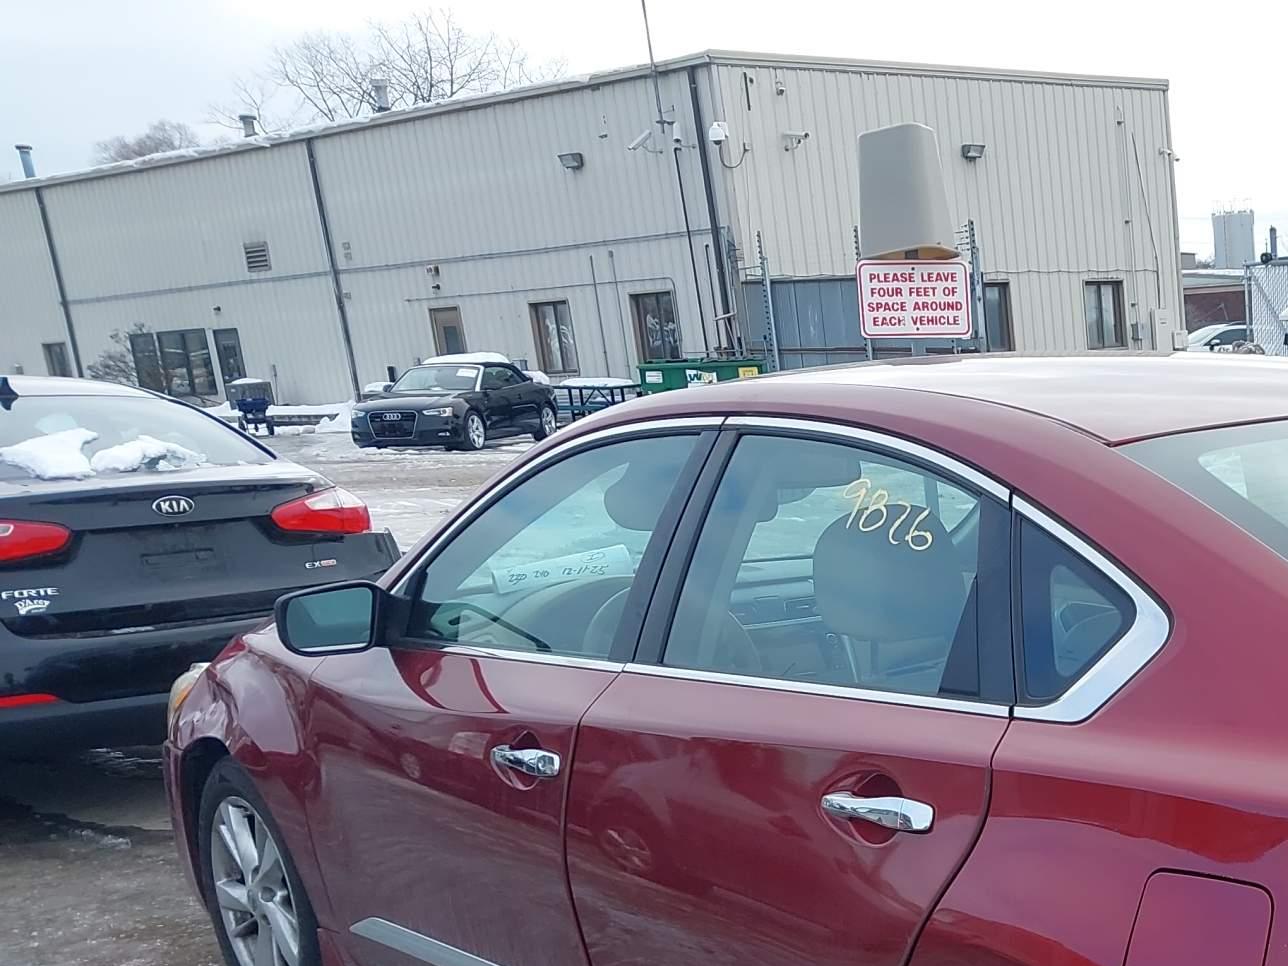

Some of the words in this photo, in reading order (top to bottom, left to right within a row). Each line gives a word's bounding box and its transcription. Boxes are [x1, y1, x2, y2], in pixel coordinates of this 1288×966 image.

[869, 272, 915, 283] PLEASE
[921, 271, 957, 282] LEAVE
[870, 287, 903, 297] FOUR
[909, 286, 937, 297] FEET
[943, 286, 958, 297] OF
[867, 301, 907, 312] SPACE
[912, 300, 963, 311] AROUND
[872, 316, 906, 326] EACH
[911, 315, 960, 326] VEHICLE
[159, 499, 190, 513] KIA
[305, 561, 321, 569] EX
[1, 587, 60, 600] FORTE
